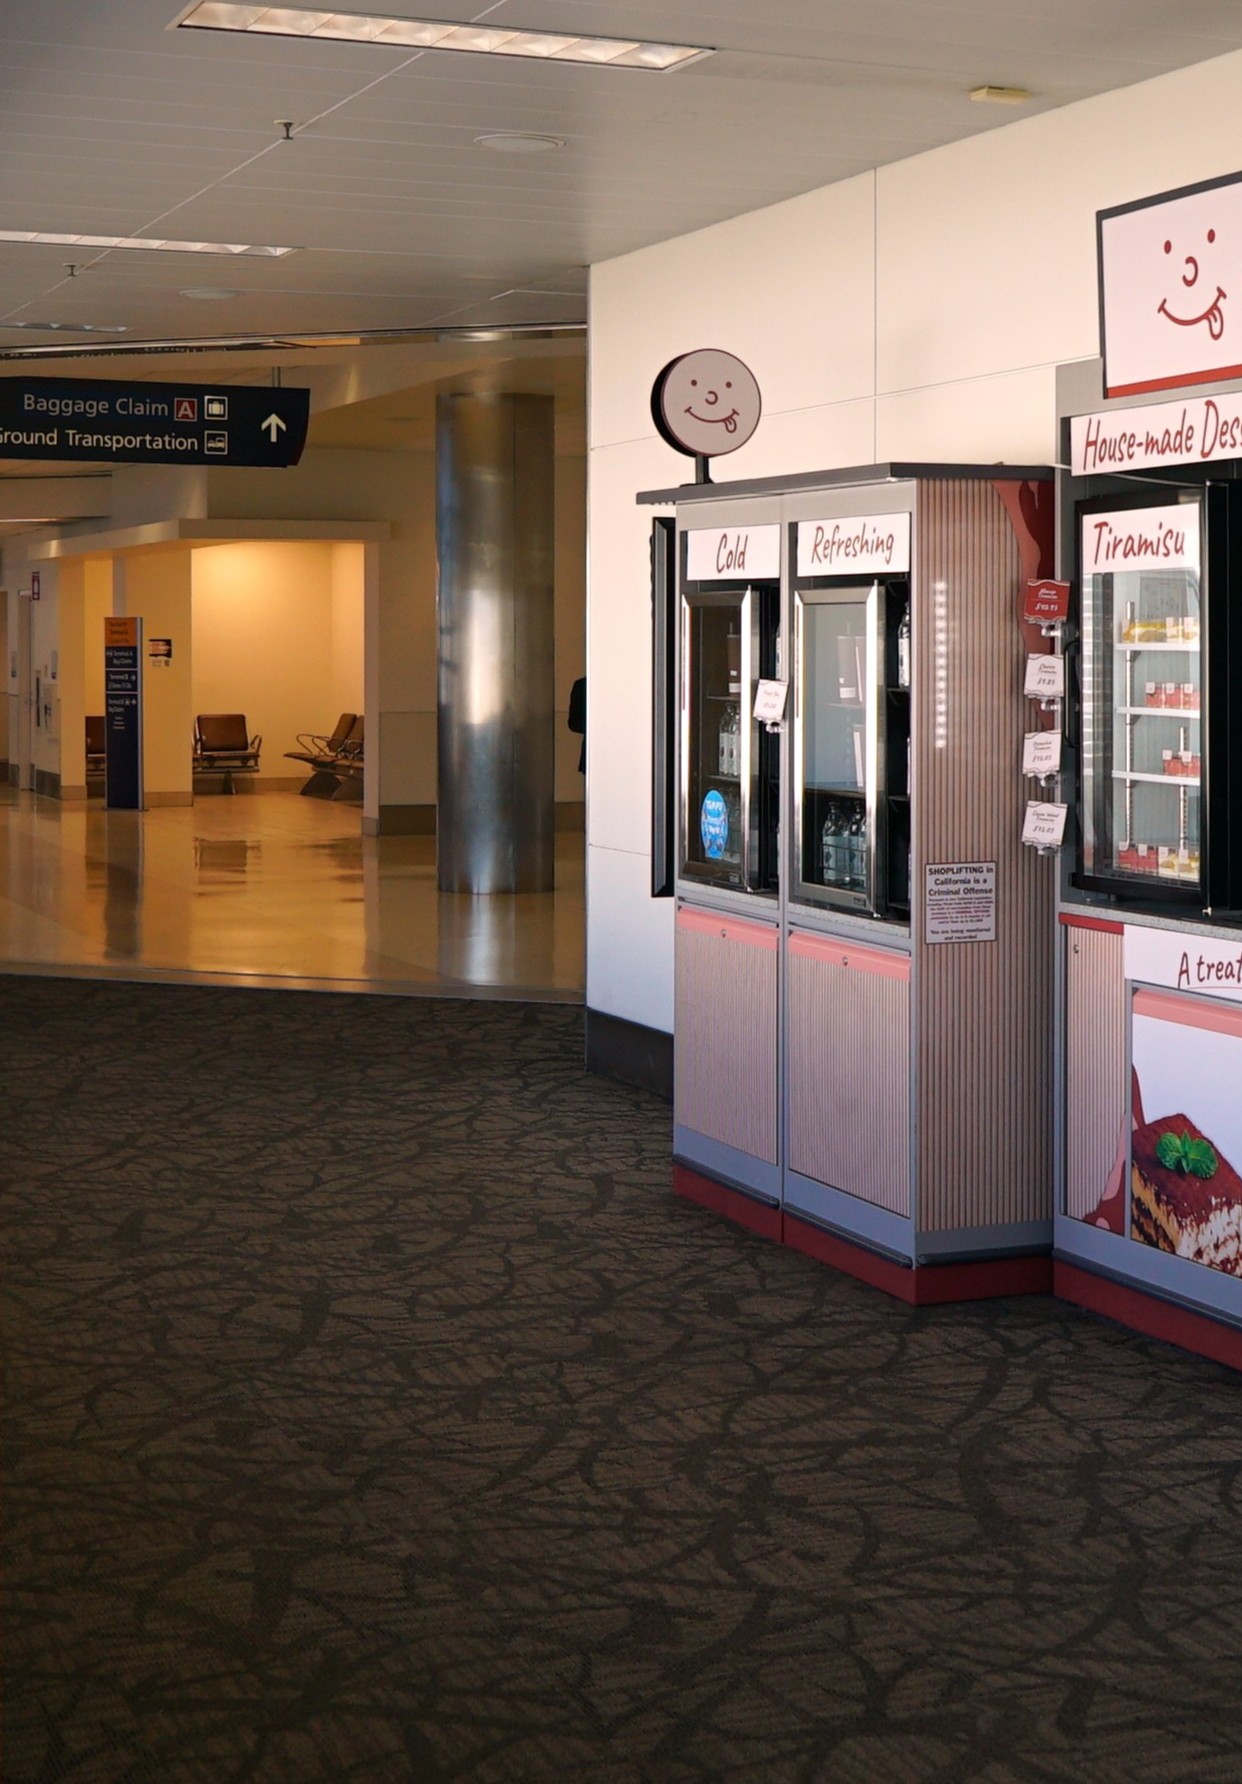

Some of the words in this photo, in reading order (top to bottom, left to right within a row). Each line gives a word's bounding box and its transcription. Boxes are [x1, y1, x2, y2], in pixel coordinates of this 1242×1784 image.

[23, 394, 109, 418] Baggage
[115, 398, 169, 417] Claim
[177, 401, 194, 419] A
[0, 427, 58, 446] round
[65, 430, 198, 452] Transportation
[1083, 408, 1195, 471] House-made
[716, 533, 749, 574] Cold
[811, 522, 895, 566] Refreshing
[1094, 521, 1185, 565] Tiramisu
[928, 866, 984, 876] SHOPLIFTING
[934, 877, 971, 886] California
[973, 876, 981, 884] is
[928, 887, 960, 897] Criminal
[963, 887, 993, 895] Offense
[1177, 951, 1191, 988] A
